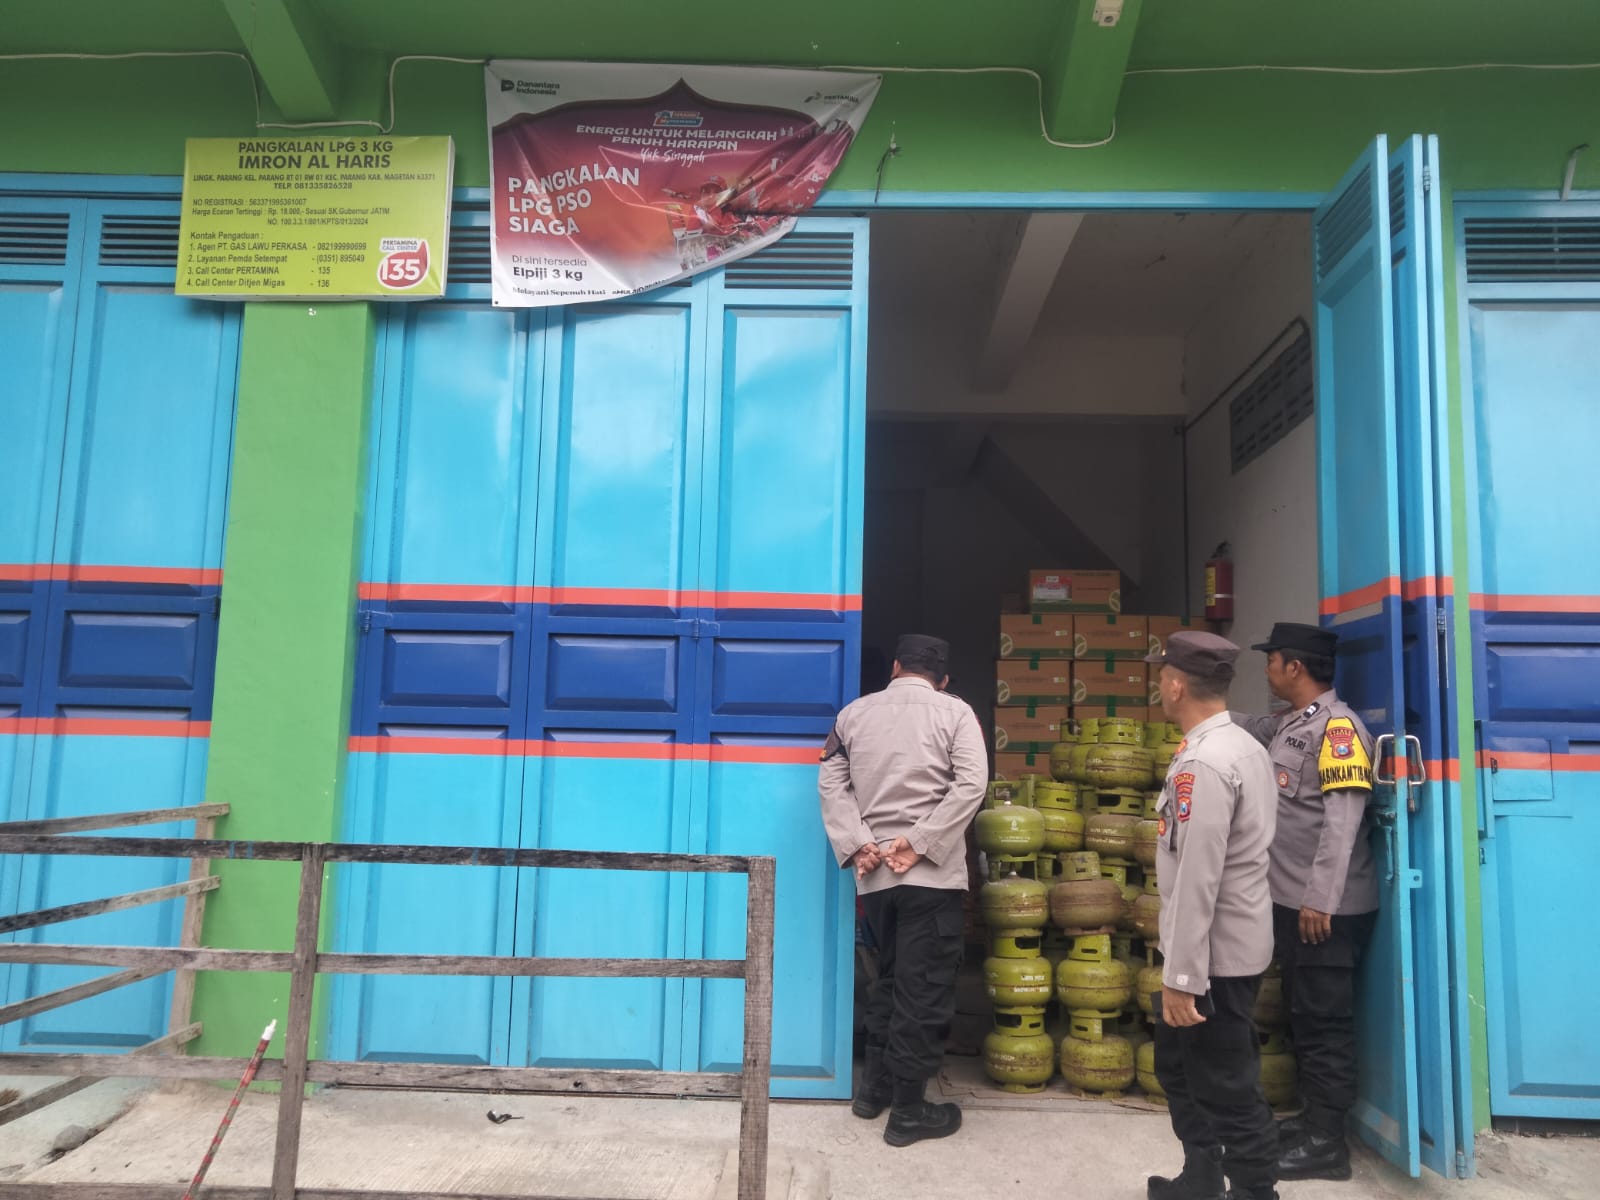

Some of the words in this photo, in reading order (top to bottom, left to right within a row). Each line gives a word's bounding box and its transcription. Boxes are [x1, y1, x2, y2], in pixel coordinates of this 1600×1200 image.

[517, 80, 560, 89] Danantara
[516, 87, 557, 96] Indonesia
[576, 124, 629, 135] ENERGI
[632, 128, 682, 138] UNTUK
[685, 129, 777, 141] MELANGKAH
[238, 141, 325, 153] PANGKALAN
[329, 141, 356, 153] LPG
[360, 141, 369, 153] 3
[372, 140, 393, 153] KG
[611, 136, 664, 146] PENUH
[666, 139, 738, 151] HARAPAN
[238, 155, 302, 169] IMRON
[307, 155, 330, 169] AL
[336, 154, 391, 168] HARIS
[640, 147, 660, 163] Yuk
[663, 149, 705, 168] Singgah
[384, 173, 415, 181] MAGETAN
[508, 163, 640, 195] PANGKALAN
[193, 198, 203, 206] NO
[204, 198, 244, 206] REGISTRASI
[509, 196, 553, 216] LPG
[556, 188, 592, 214] PSO
[192, 208, 211, 217] Harga
[235, 208, 263, 217] Tertinggi
[508, 216, 580, 236] SIAGA
[190, 231, 216, 240] Kontak
[218, 231, 260, 241] Pengaduan
[197, 242, 216, 252] Agen
[230, 242, 246, 250] GAS
[248, 242, 270, 250] LAWU
[271, 242, 307, 251] PERKASA
[197, 254, 226, 264] Layanan
[228, 254, 253, 263] Pemda
[254, 254, 288, 264] Setempat
[511, 254, 523, 264] Di
[524, 255, 542, 265] sini
[543, 256, 588, 267] tersedia
[195, 266, 209, 275] Call
[211, 266, 235, 275] Center
[236, 266, 280, 275] PERTAMINA
[318, 266, 331, 275] 135
[382, 257, 420, 281] 135
[513, 266, 548, 280] Elpiji
[552, 269, 561, 279] 3
[565, 269, 583, 281] kg
[195, 278, 210, 287] Call
[211, 278, 237, 287] Center
[238, 278, 261, 288] Ditjen
[262, 278, 286, 288] Migas
[512, 287, 550, 297] Melayani
[550, 289, 586, 297] Sepenuh
[1285, 736, 1307, 751] POLRI
